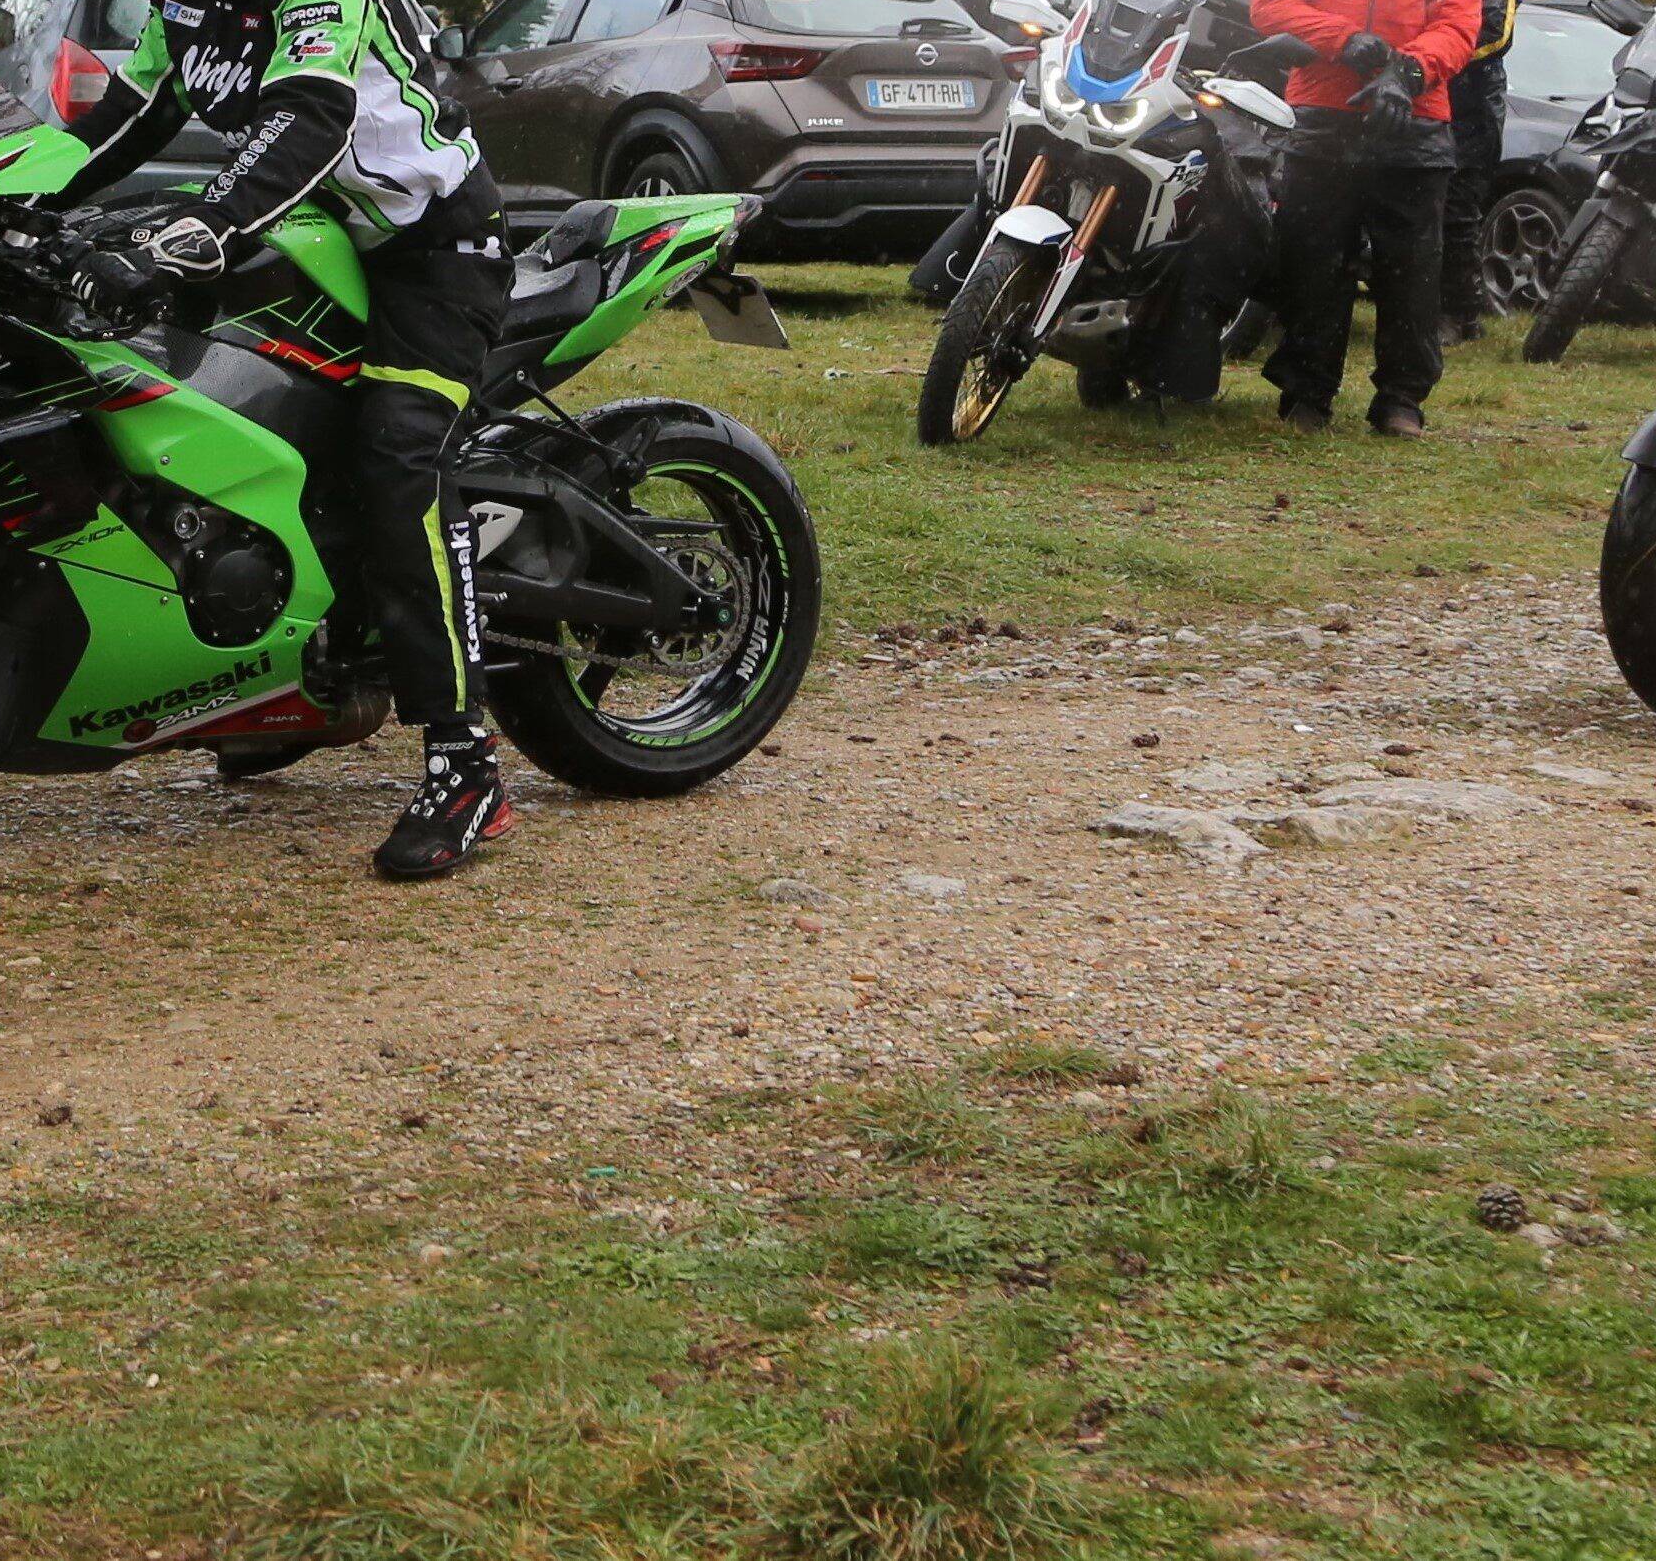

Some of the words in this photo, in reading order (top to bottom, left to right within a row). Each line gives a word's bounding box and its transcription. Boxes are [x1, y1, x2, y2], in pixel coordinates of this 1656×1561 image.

[881, 83, 961, 103] GF-477-RH
[807, 118, 844, 127] JUKE
[51, 523, 126, 556] ZX-10R
[449, 521, 482, 663] Kawasaki
[736, 613, 770, 682] NINJA
[68, 650, 273, 739] Kawasaki
[154, 688, 240, 730] 24MX
